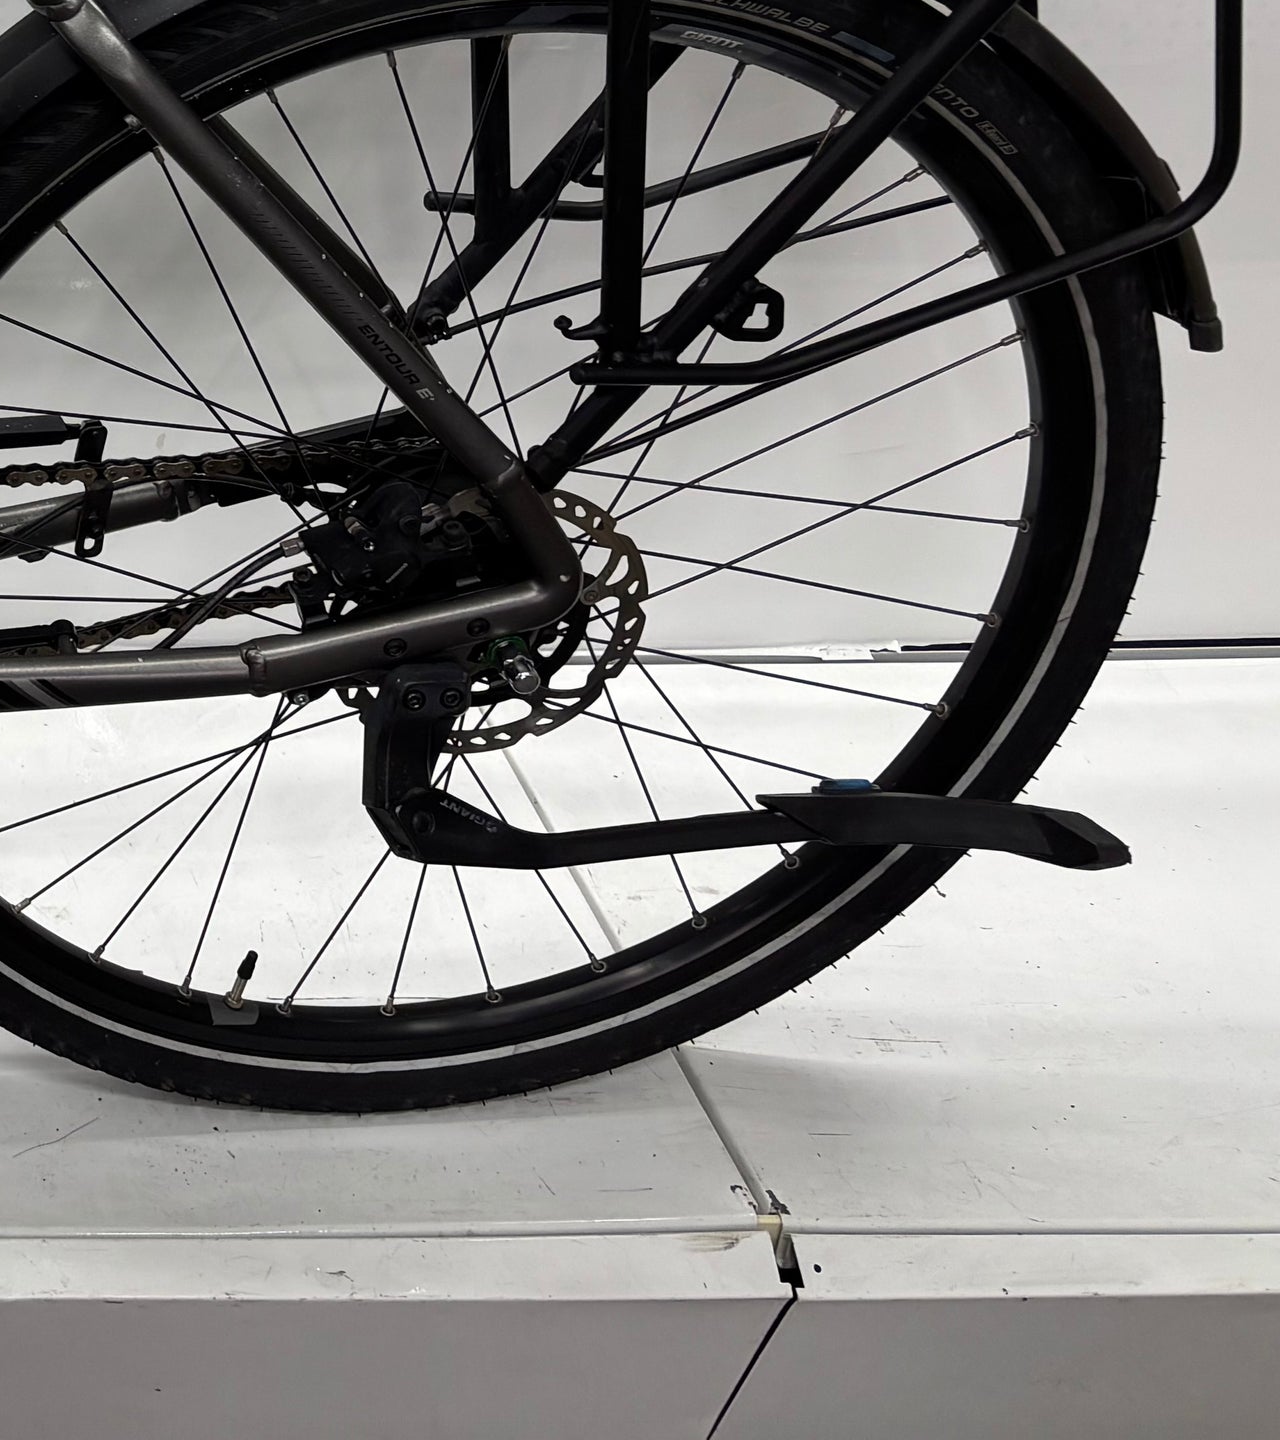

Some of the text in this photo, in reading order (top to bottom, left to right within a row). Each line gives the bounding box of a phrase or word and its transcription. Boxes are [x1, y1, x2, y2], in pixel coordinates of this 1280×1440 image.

[680, 31, 744, 49] GIANT
[358, 325, 420, 385] ENTOUR
[439, 799, 486, 826] GIANT
